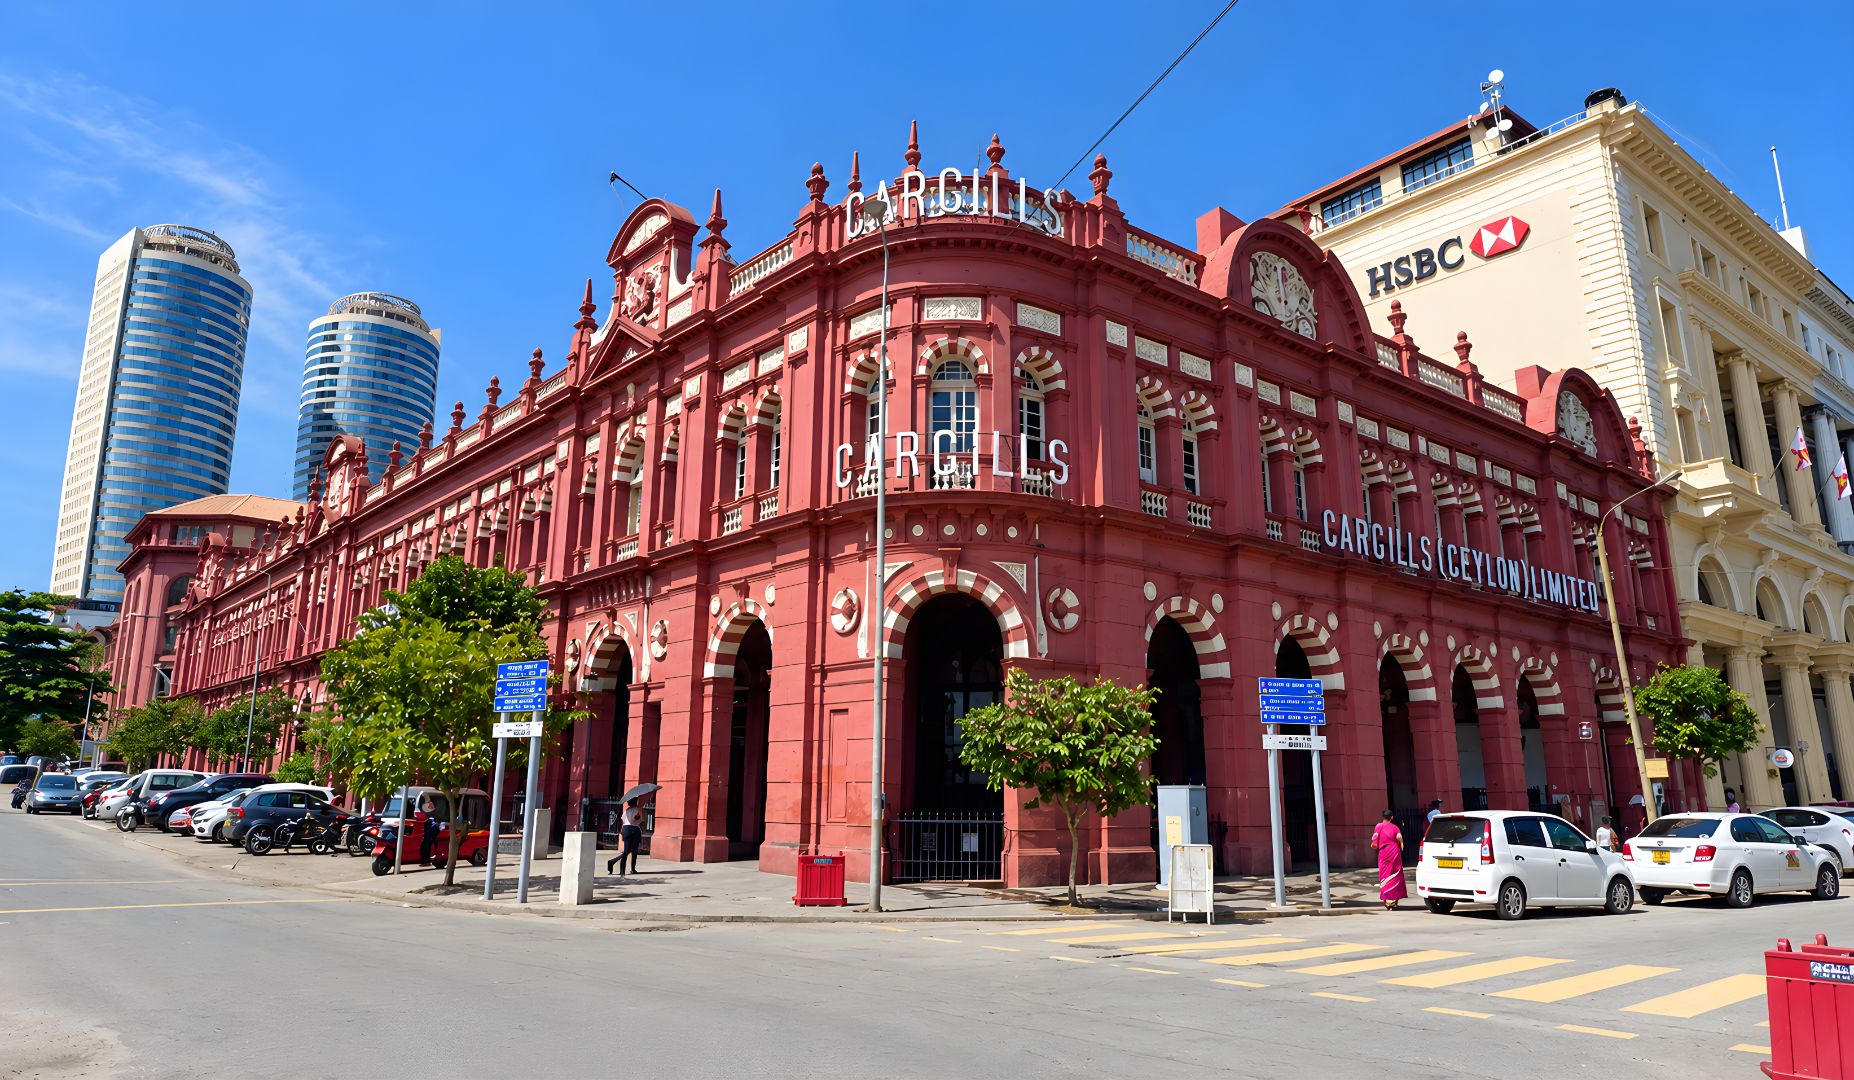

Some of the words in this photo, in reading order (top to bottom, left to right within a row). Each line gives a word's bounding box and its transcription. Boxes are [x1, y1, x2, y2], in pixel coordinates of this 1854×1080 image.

[846, 167, 1062, 238] CARGILLS
[1366, 236, 1464, 296] HSBC
[836, 429, 1069, 488] CARGILLS
[1323, 509, 1432, 572] CARGILLS
[1437, 538, 1529, 598] (CEYLON)
[1530, 566, 1599, 612] LIMITED
